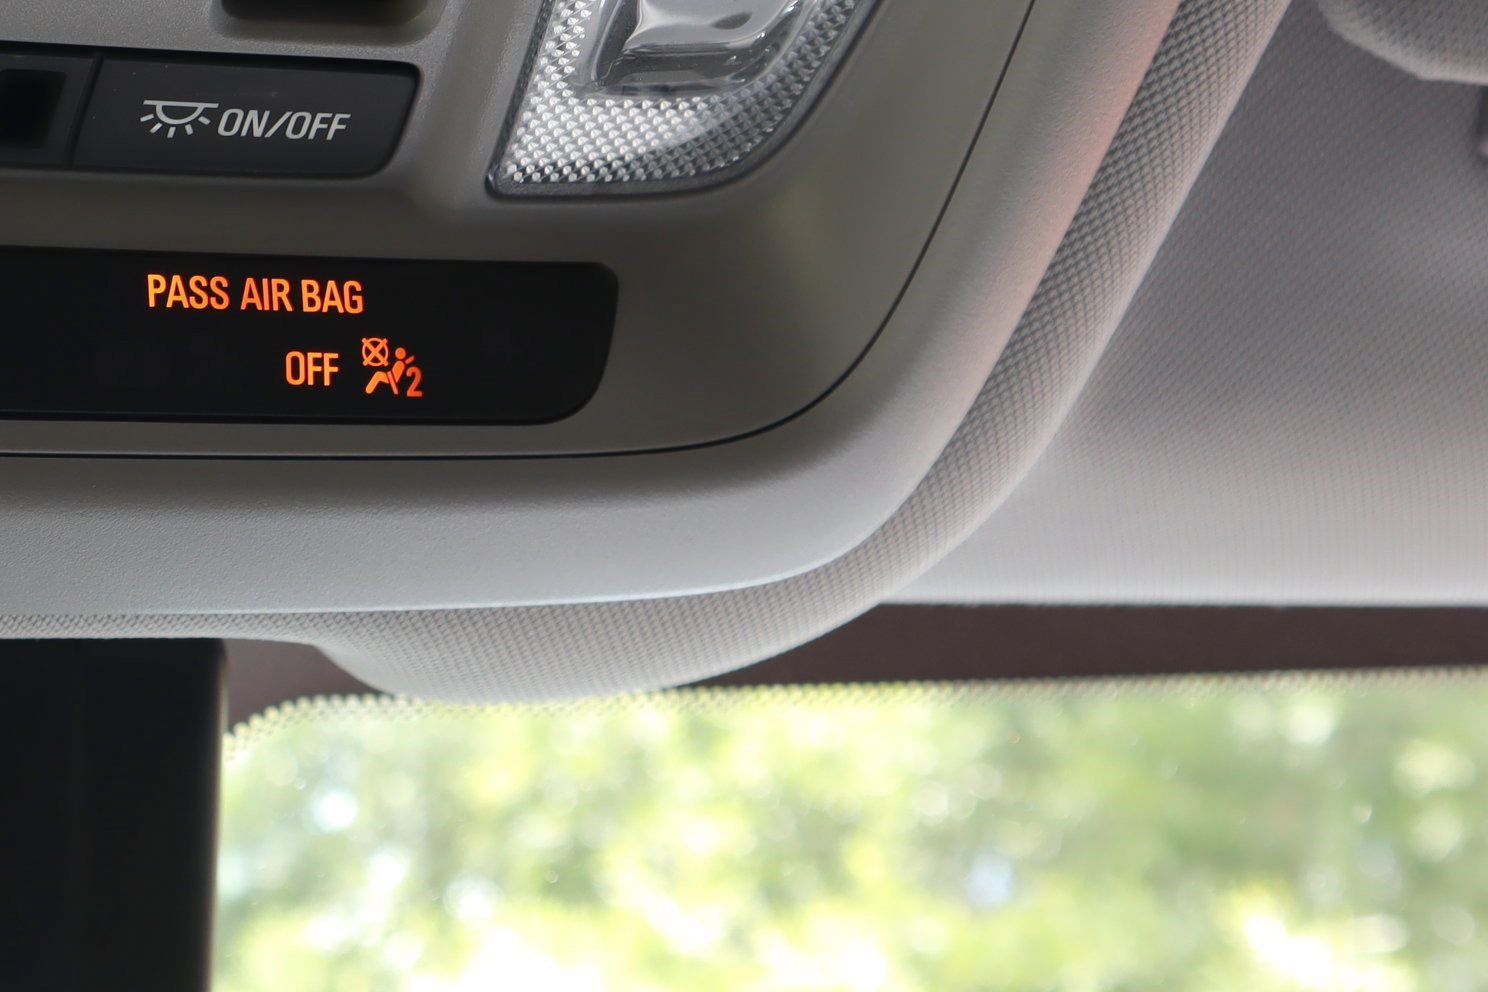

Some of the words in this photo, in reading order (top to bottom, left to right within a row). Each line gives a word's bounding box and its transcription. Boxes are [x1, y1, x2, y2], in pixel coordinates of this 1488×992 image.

[217, 108, 351, 141] ON/OFF
[147, 273, 230, 310] PASS
[240, 277, 293, 312] AIR
[301, 279, 364, 314] BAG
[285, 351, 339, 386] OFF
[406, 366, 423, 397] 2
